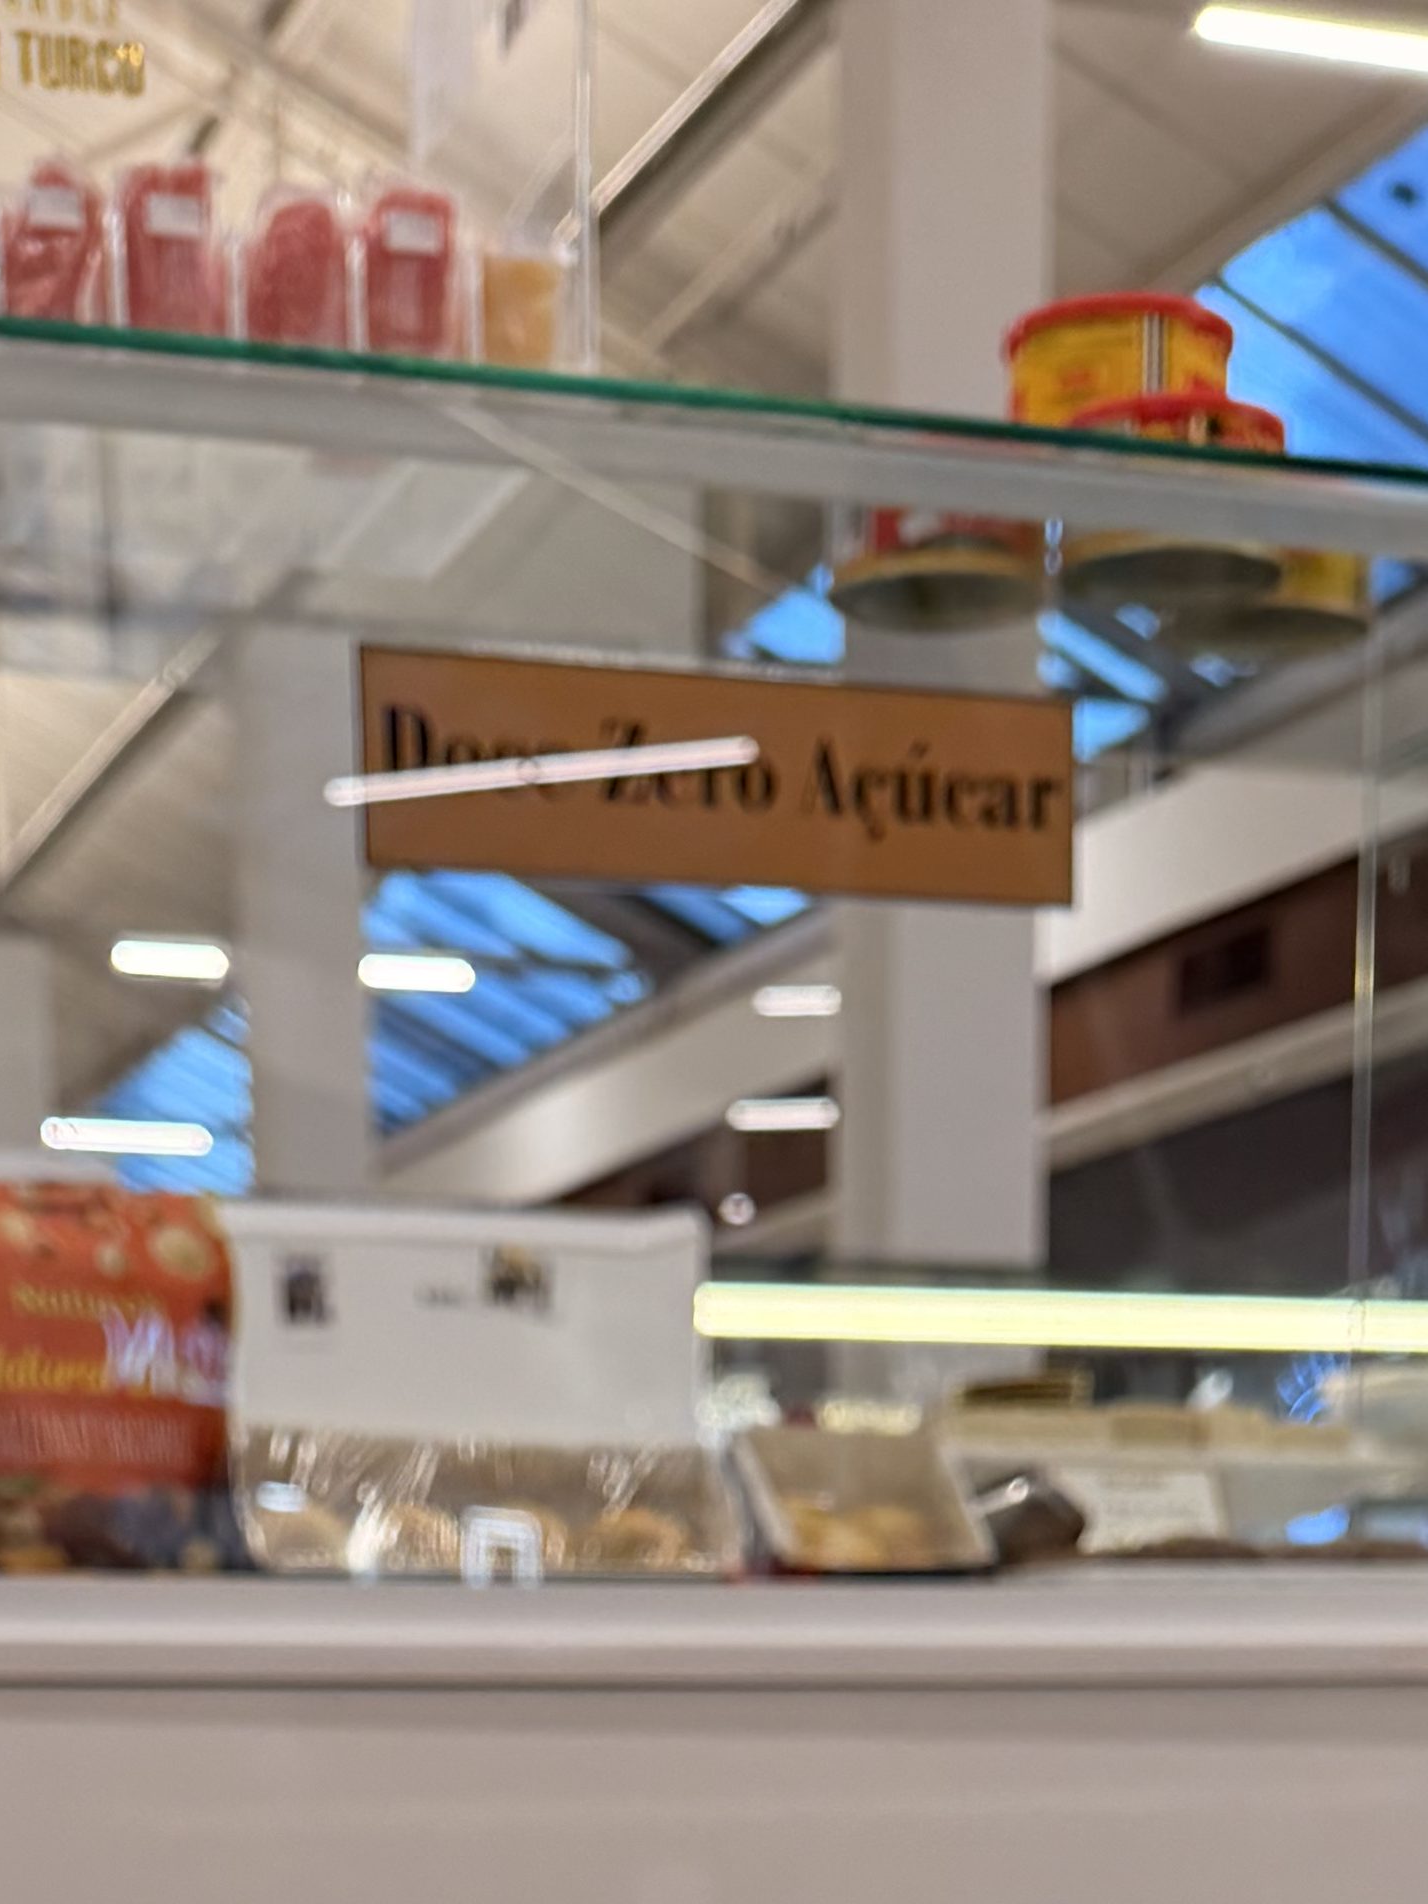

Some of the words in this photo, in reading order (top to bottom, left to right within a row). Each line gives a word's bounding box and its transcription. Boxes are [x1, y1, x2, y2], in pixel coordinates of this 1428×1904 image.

[15, 28, 147, 96] TURCO
[382, 704, 566, 800] Do
[801, 737, 1069, 843] Açúcar
